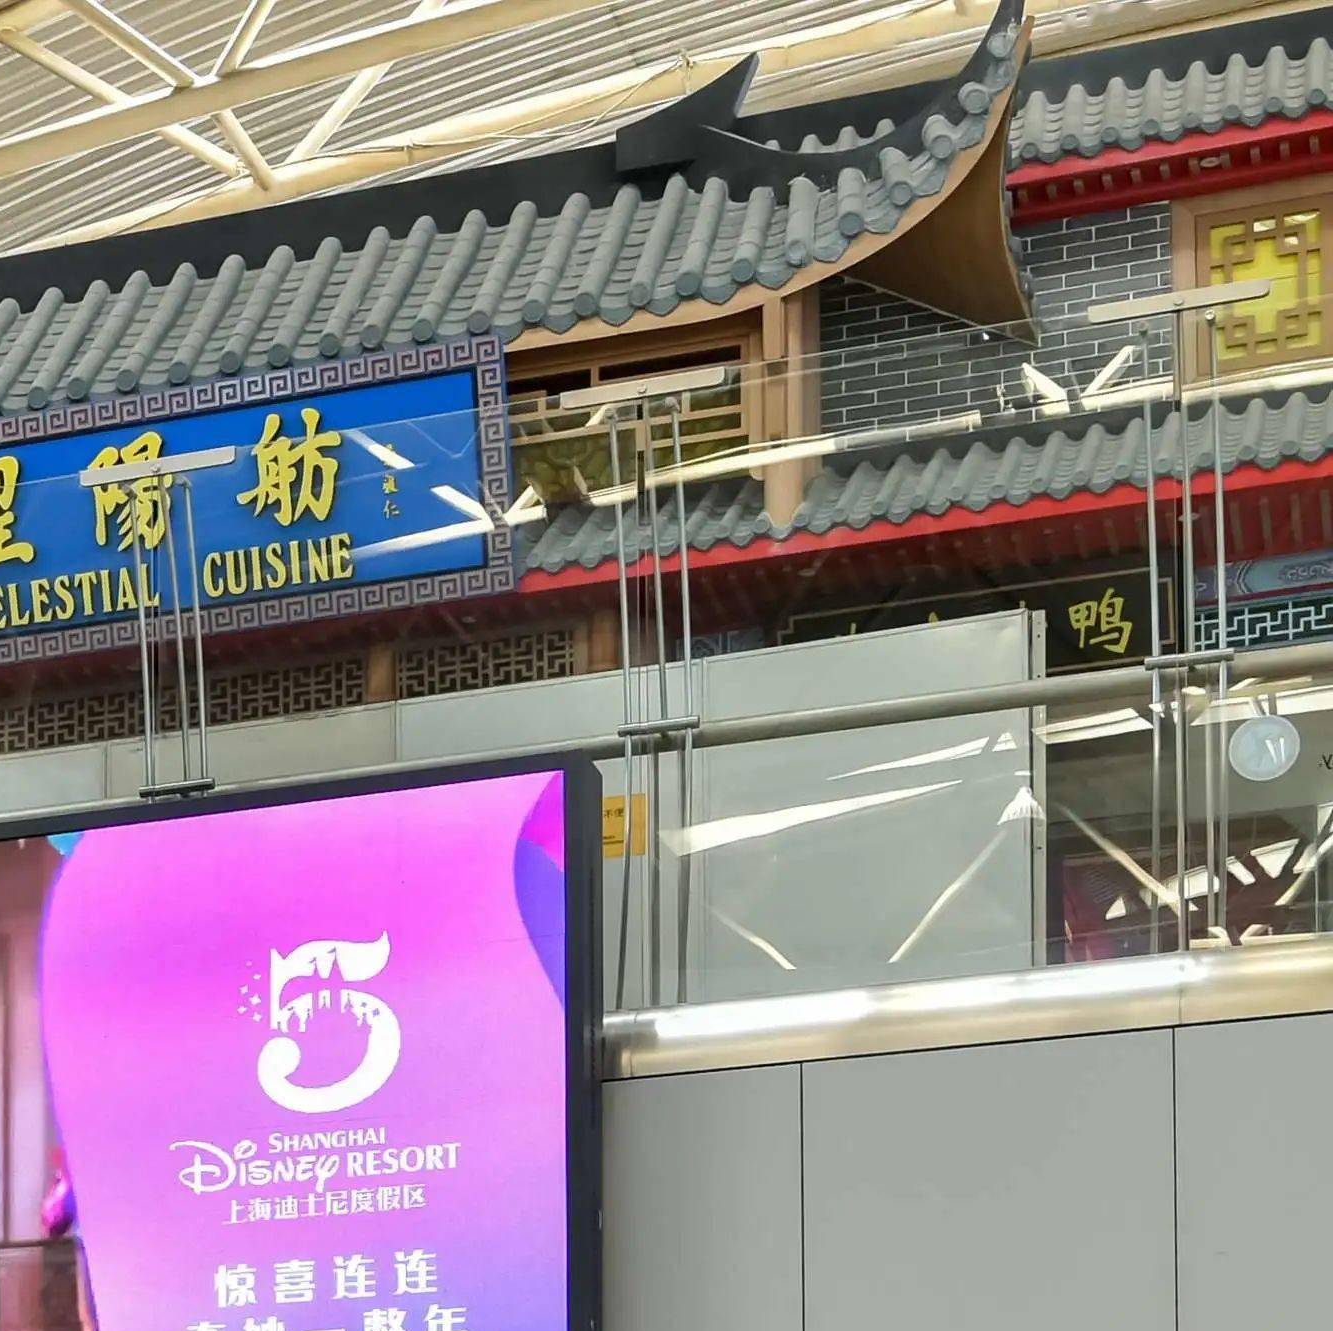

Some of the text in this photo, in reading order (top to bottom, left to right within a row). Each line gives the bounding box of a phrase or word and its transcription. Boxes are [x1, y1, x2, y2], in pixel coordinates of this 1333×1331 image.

[202, 532, 355, 598] CUISINE
[268, 1126, 387, 1154] SHANGHAI
[346, 1141, 462, 1178] RESORT
[221, 1183, 427, 1225] 上海迪士尼度假区
[213, 1248, 439, 1309] 惊喜连连
